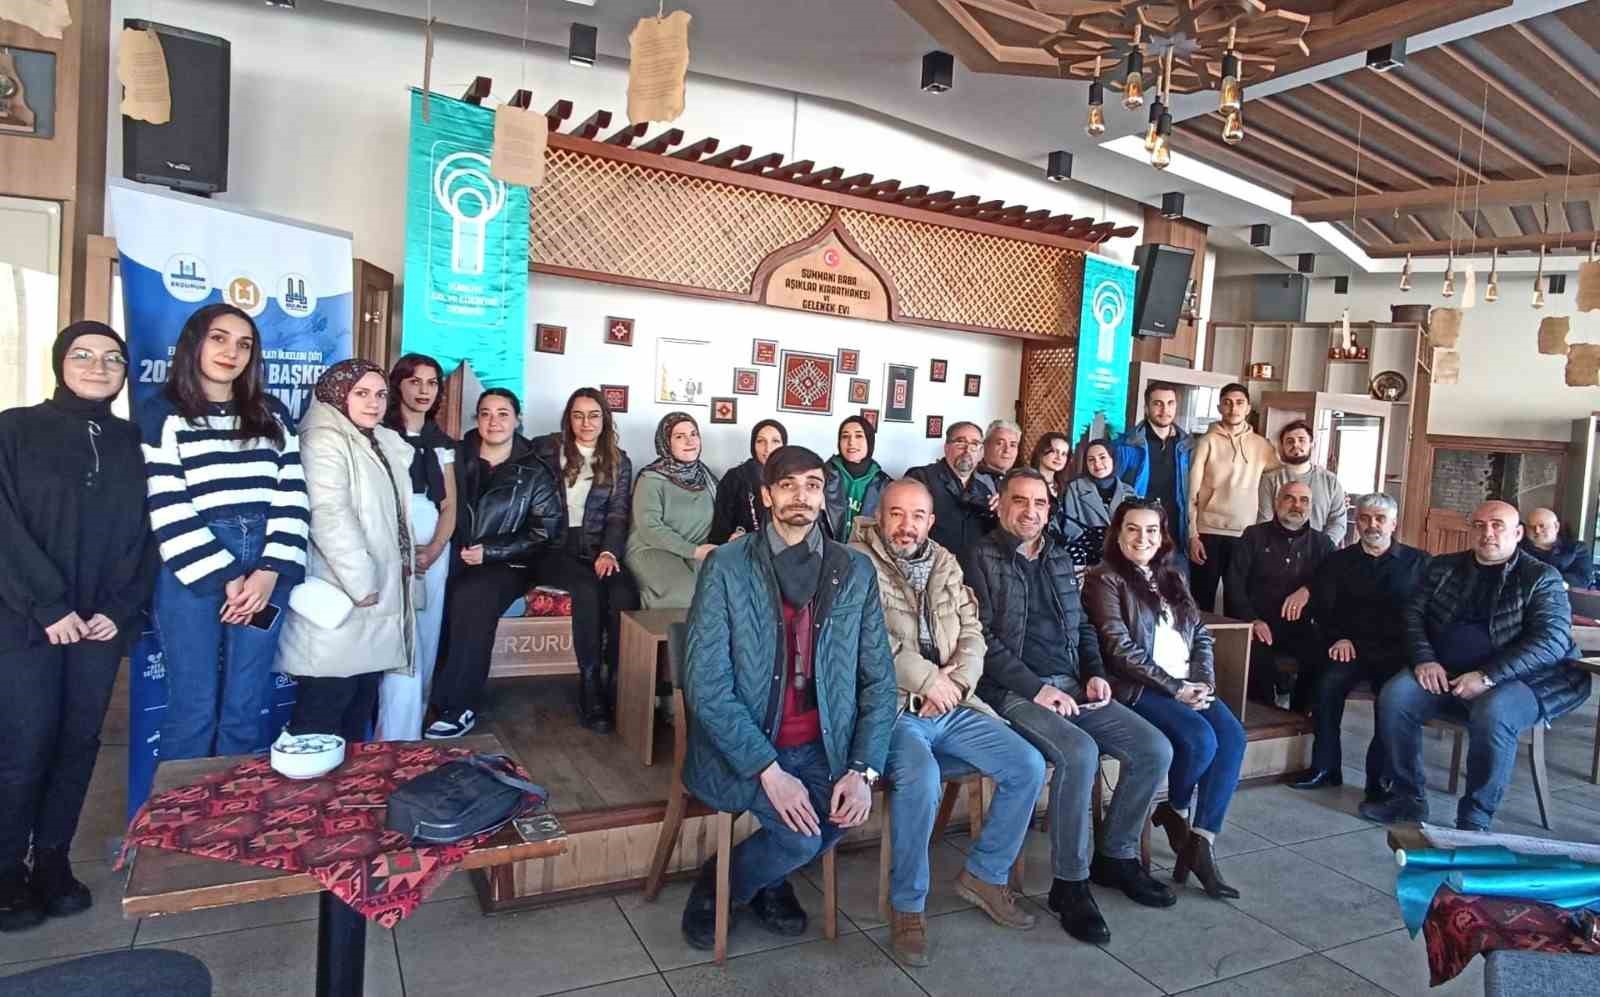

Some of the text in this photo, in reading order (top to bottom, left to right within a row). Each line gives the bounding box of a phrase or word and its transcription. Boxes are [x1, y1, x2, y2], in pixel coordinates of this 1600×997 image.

[838, 274, 857, 286] BABA
[802, 299, 836, 313] GELENEK
[268, 363, 328, 389] BAŞKE
[492, 634, 572, 654] ERZURU
